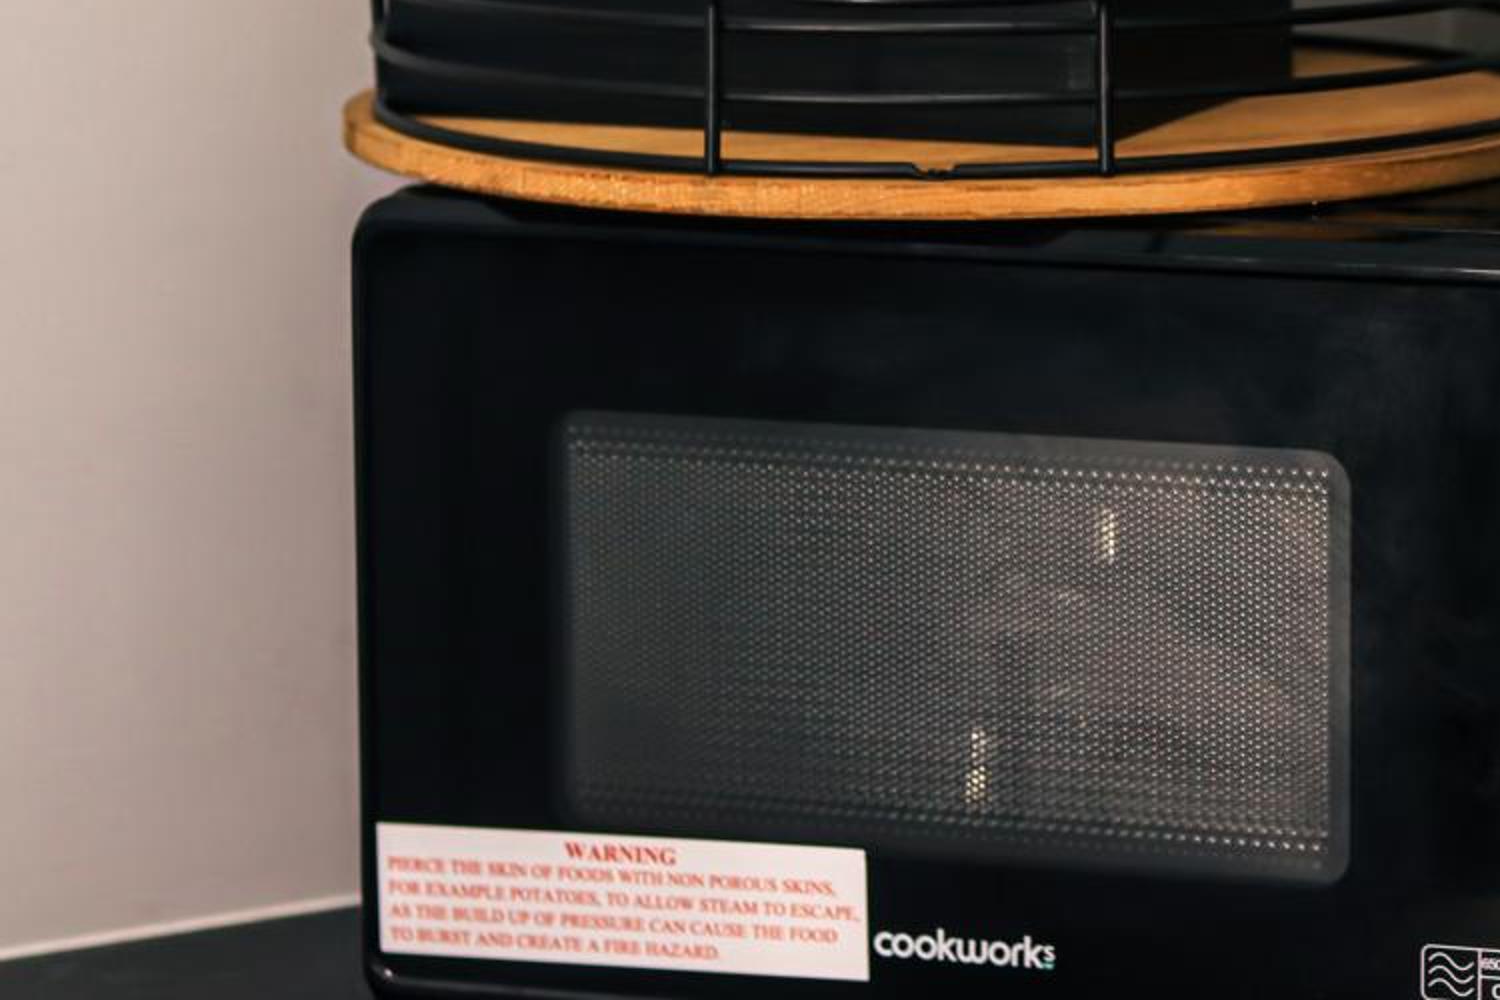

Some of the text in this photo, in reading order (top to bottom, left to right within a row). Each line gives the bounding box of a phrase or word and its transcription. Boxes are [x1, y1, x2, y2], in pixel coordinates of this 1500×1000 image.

[563, 841, 677, 865] WARNING
[387, 857, 446, 874] PIERCE
[451, 860, 483, 876] THE
[487, 862, 529, 879] SKIN
[534, 865, 556, 880] OF
[558, 866, 615, 883] FOODS
[618, 870, 663, 885] WITH
[667, 872, 705, 887] NON
[710, 875, 778, 892] POROUS
[388, 880, 421, 896] FOR
[426, 882, 506, 900] EXAMPLE
[606, 892, 630, 906] TO
[635, 894, 695, 911] ALLOW
[700, 897, 759, 915] STEAM
[764, 900, 787, 916] TO
[392, 903, 838, 943] AS THE BUILD UP OF PRESSURE CAN CAUSE THE FOOD
[391, 926, 414, 941] TO
[417, 928, 472, 946] BURST
[475, 930, 514, 948] AND
[517, 933, 584, 952] CREATE
[587, 937, 600, 952] A
[603, 938, 643, 956] FIRE
[873, 928, 1056, 970] cookworks
